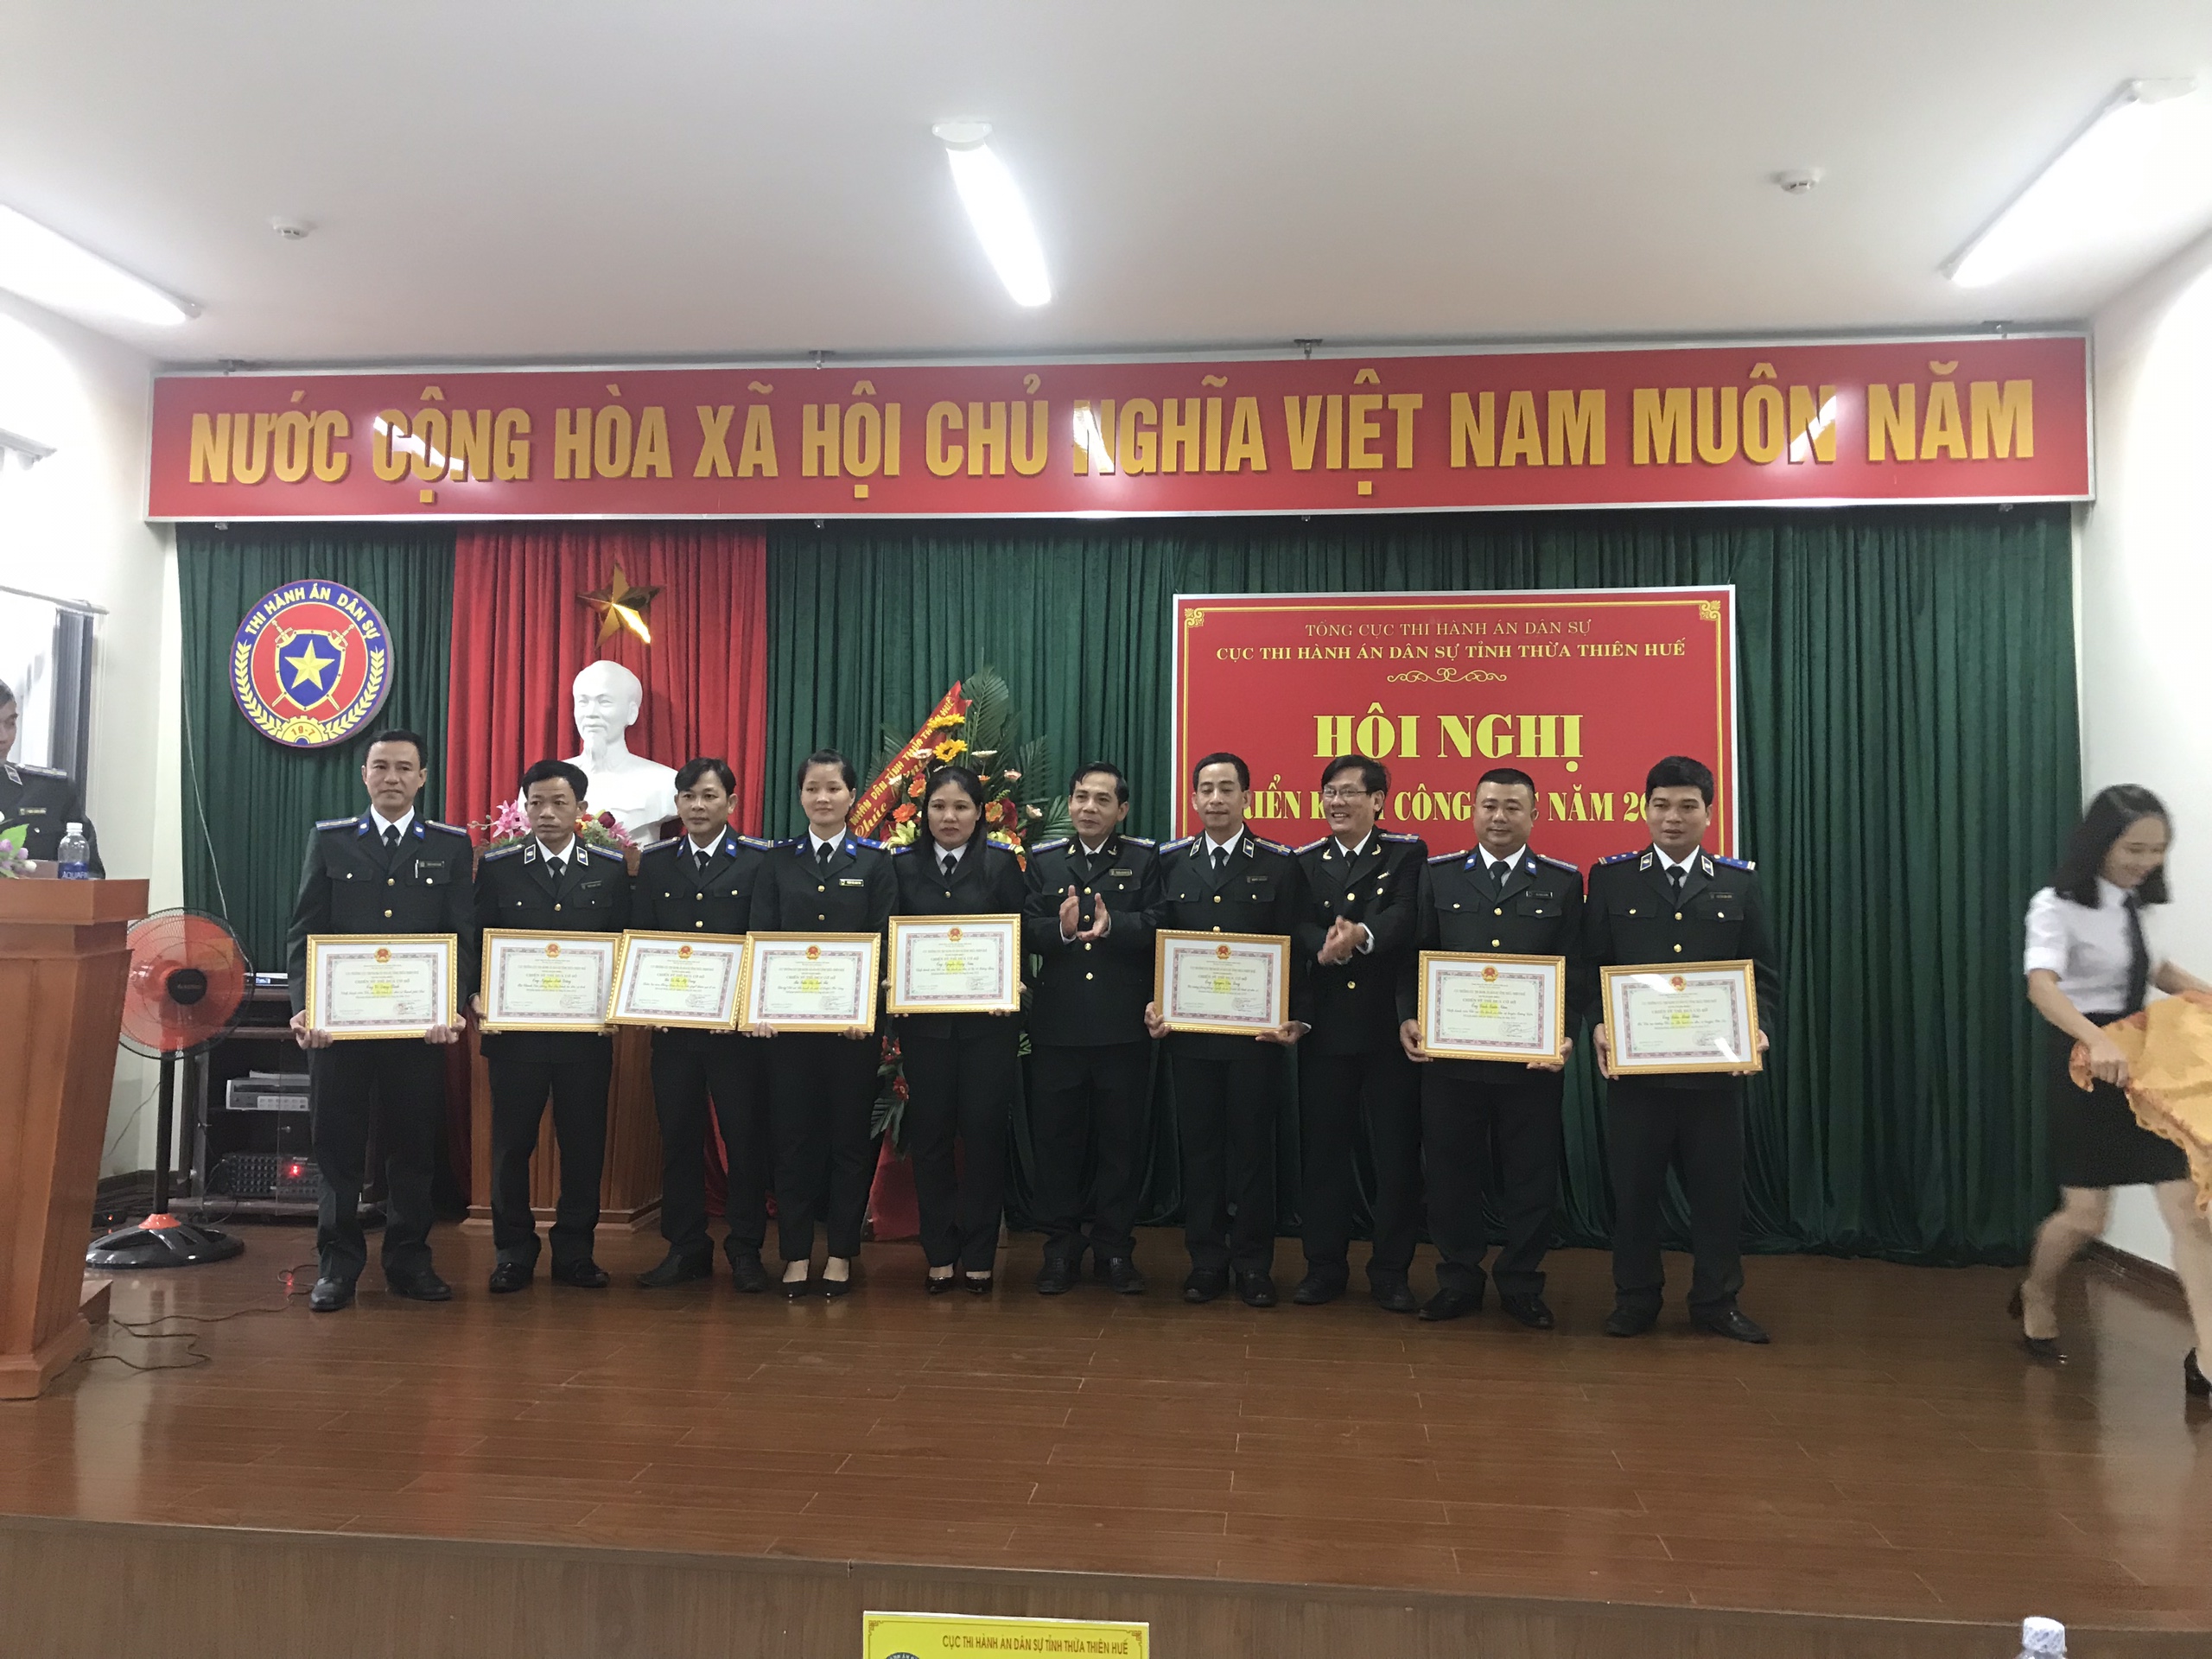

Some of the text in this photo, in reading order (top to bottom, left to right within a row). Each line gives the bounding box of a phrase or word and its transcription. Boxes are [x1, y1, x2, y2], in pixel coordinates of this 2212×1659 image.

[189, 359, 2034, 503] NƯỚC CỘNG HÒA XÃ HỘI CHỦ NGHĨA VIỆT NAM MUÔN NĂM
[245, 611, 267, 635] THI
[264, 587, 306, 615] HÀNH
[308, 582, 331, 601] ÁN
[336, 593, 367, 621] DÂN
[1305, 619, 1592, 639] TỔNG CỤC THI HÀNH ÁN DÂN SỰ
[1216, 638, 1686, 663] CỤC THI HÀNH ÁN DÂN SỰ TỈNH THỪA THIÊN HUẾ
[1437, 713, 1584, 772] NGHỊ
[1394, 783, 1472, 822] CÔNG
[1548, 784, 1615, 822] NĂM
[942, 1635, 961, 1650] CỤC
[963, 1636, 974, 1649] THI
[976, 1633, 998, 1649] HÀNH
[1086, 1637, 1109, 1655] THIÊN
[1111, 1637, 1128, 1656] HUẾ
